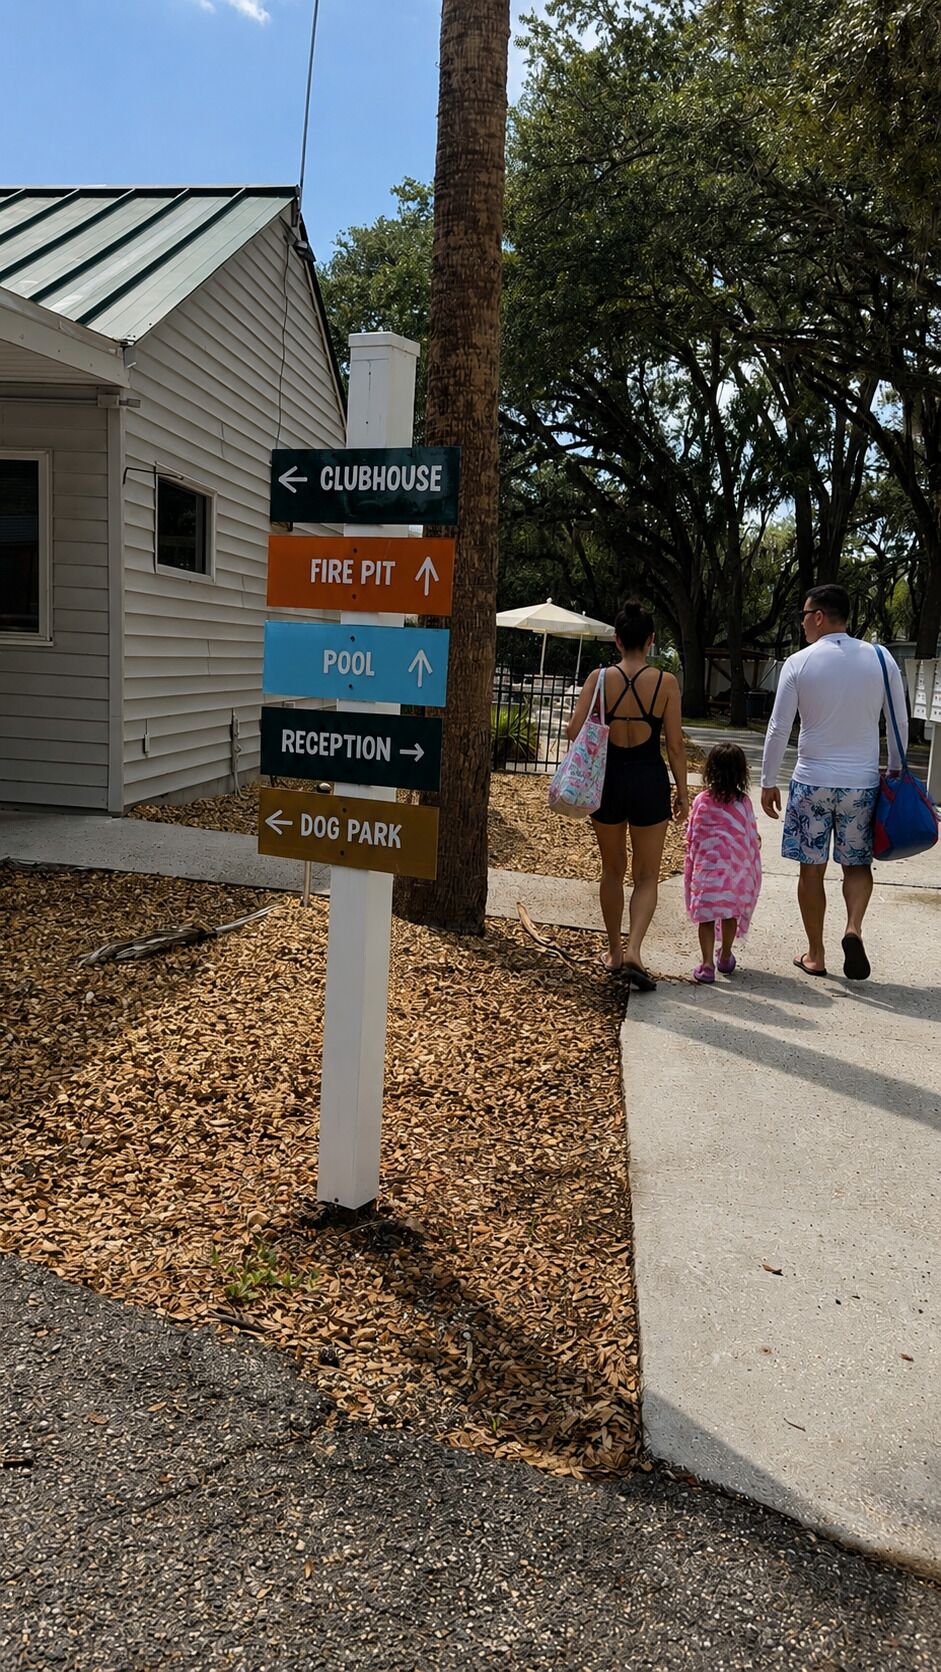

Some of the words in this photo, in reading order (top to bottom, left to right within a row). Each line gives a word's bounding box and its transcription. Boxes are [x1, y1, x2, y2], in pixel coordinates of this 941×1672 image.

[320, 464, 443, 492] CLUBHOUSE
[310, 558, 354, 585] FIRE
[360, 559, 396, 586] PIT
[323, 649, 375, 677] POOL
[281, 728, 392, 762] RECEPTION
[300, 812, 340, 840] DOG
[347, 818, 402, 849] PARK
